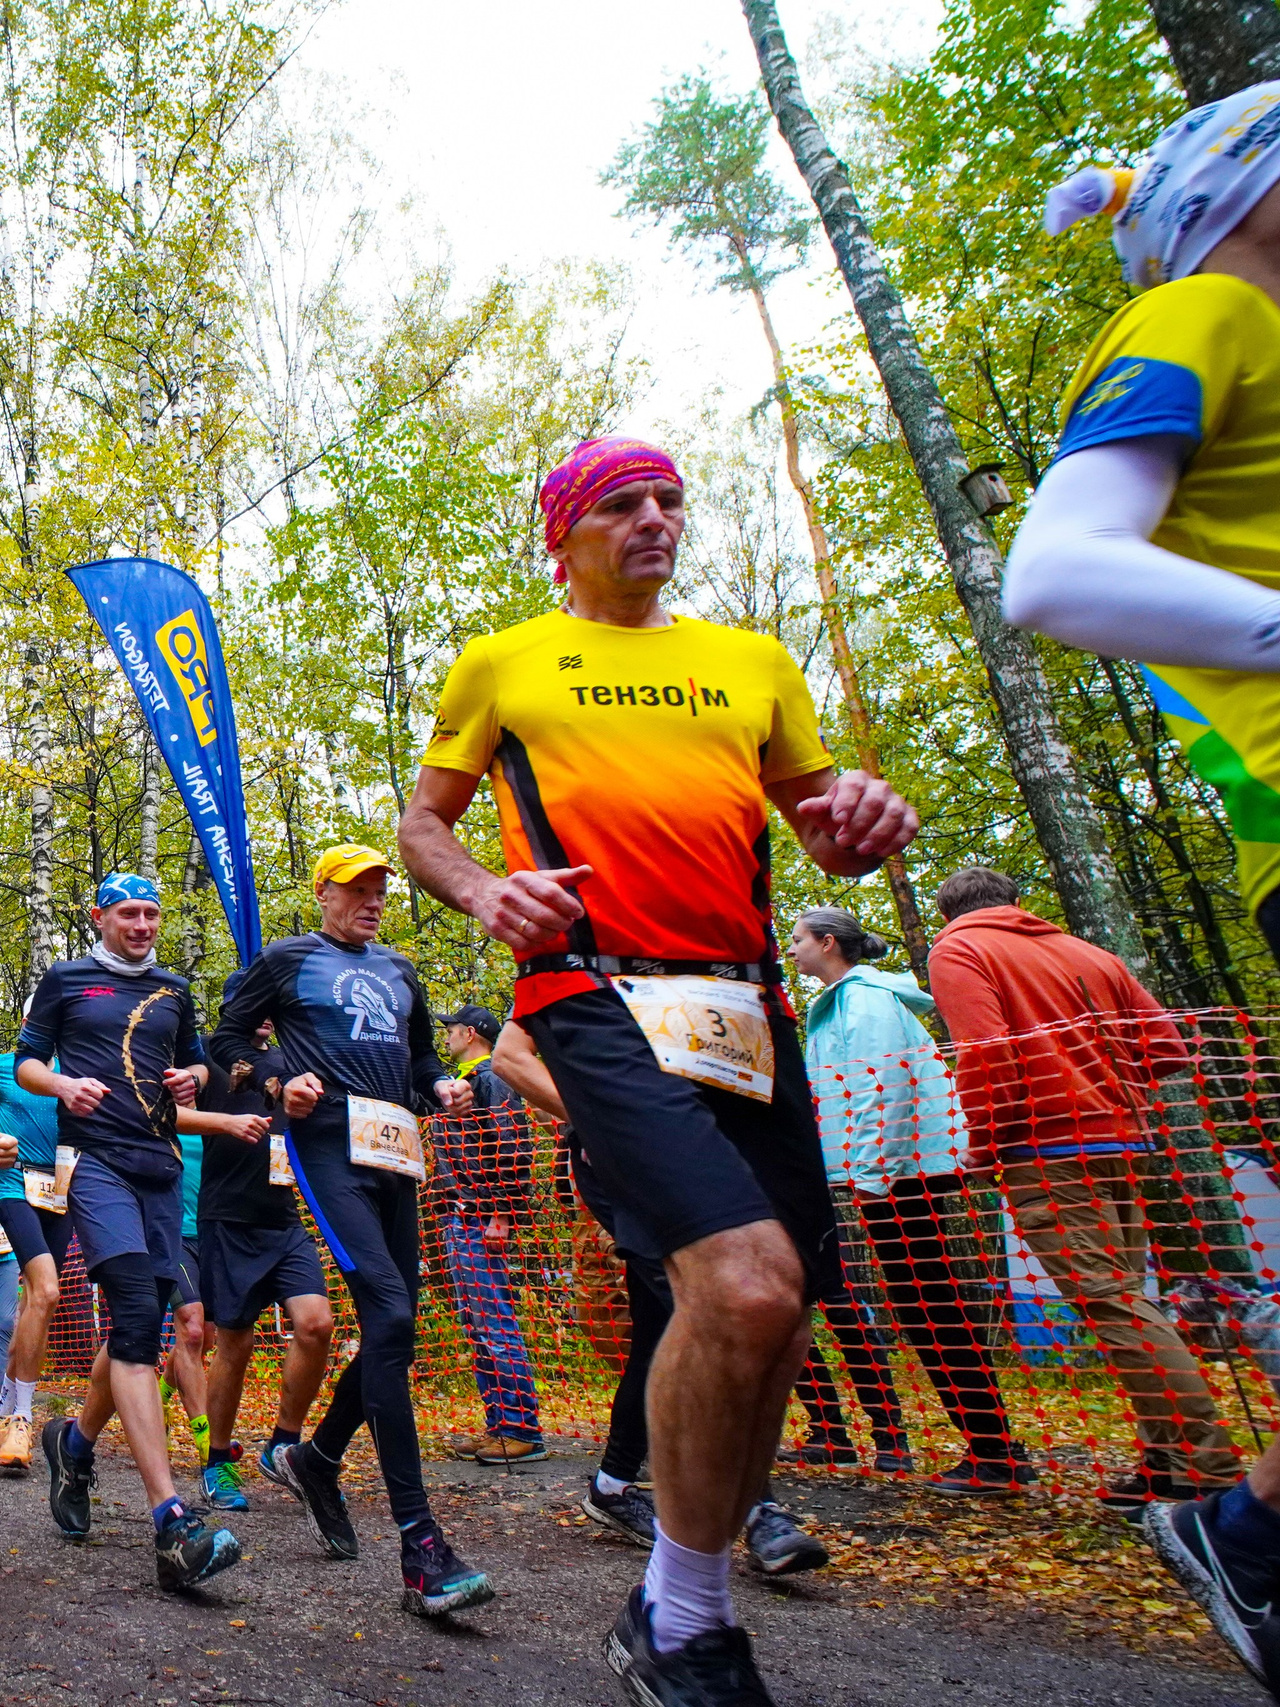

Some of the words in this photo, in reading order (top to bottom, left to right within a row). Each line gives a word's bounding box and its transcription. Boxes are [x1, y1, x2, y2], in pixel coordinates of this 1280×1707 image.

[332, 968, 357, 1006] ФЕСТИВАЛЬ
[357, 968, 400, 1011] МАРАФОНОВ
[707, 1008, 727, 1038] 3
[360, 1031, 383, 1042] ДНЕЙ
[383, 1034, 401, 1044] БЕГА
[380, 1124, 401, 1142] 47
[370, 1140, 409, 1156] Вячеслав
